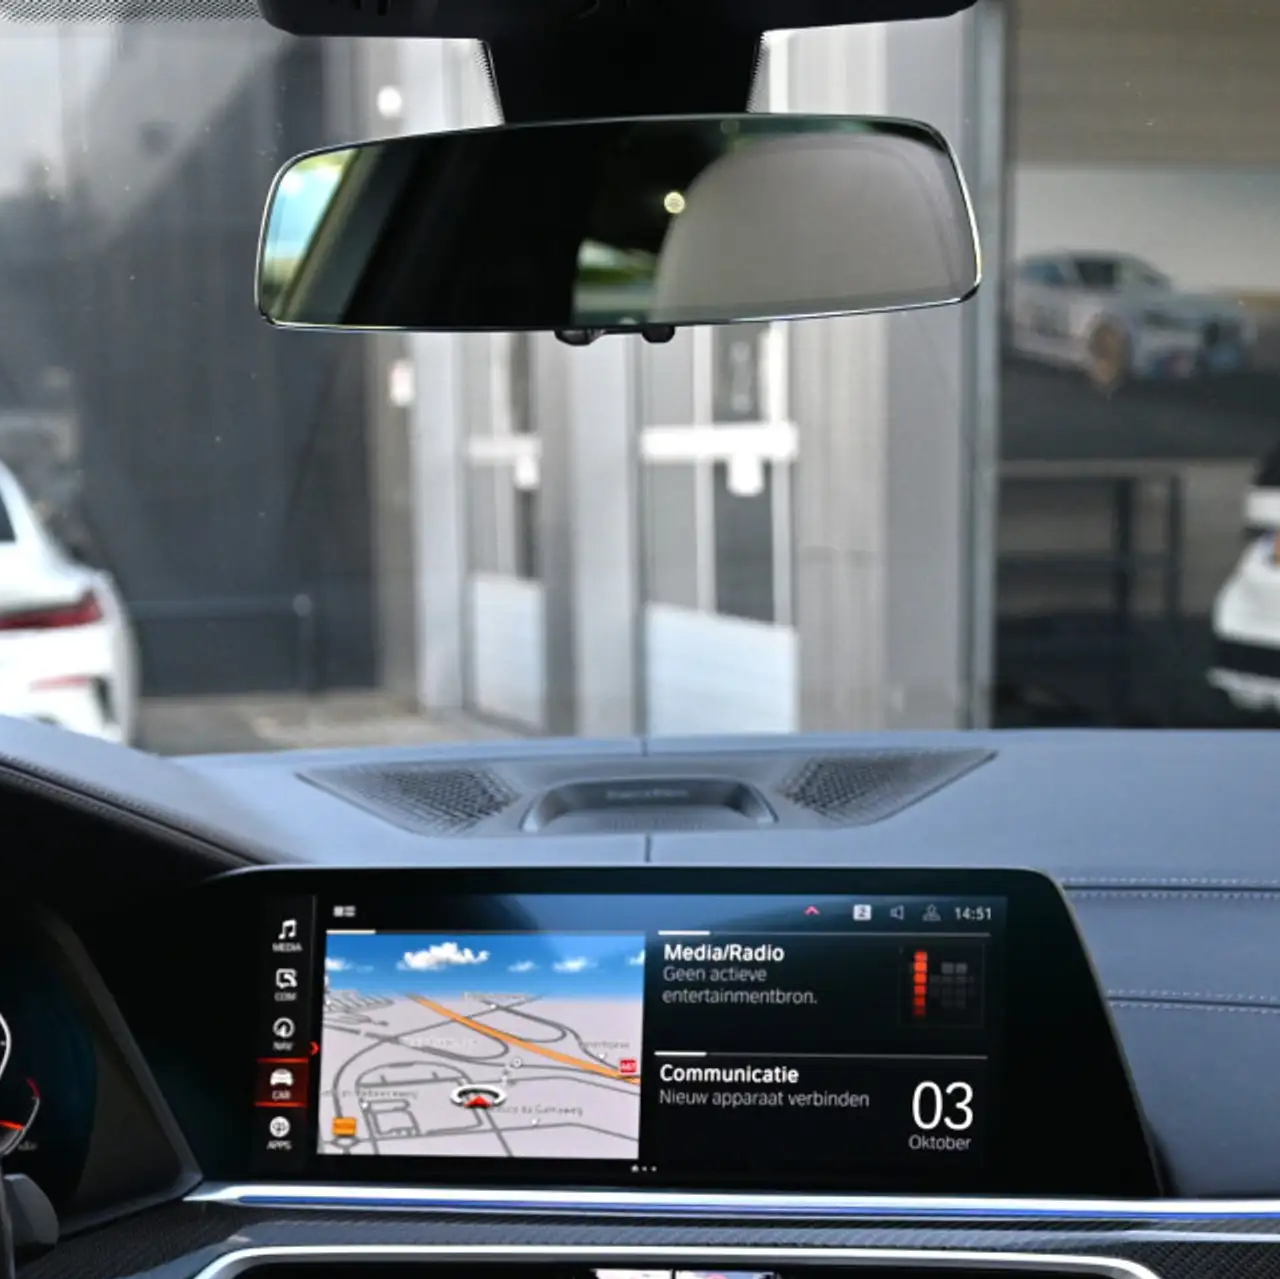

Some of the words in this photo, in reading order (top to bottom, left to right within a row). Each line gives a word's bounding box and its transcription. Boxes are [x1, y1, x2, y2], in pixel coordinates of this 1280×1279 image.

[954, 907, 992, 921] 14:51
[272, 942, 302, 952] MEDIA
[663, 943, 785, 962] Media/Radio
[662, 966, 706, 982] Geen
[710, 966, 768, 982] actieve
[662, 988, 818, 1005] entertainmentbron.
[659, 1063, 800, 1084] Communicatie
[659, 1089, 709, 1105] Nieuw
[711, 1091, 784, 1108] apparaat
[788, 1091, 870, 1108] verbinden
[912, 1080, 974, 1131] 03
[267, 1141, 292, 1151] APPS
[908, 1134, 972, 1151] Oktober
